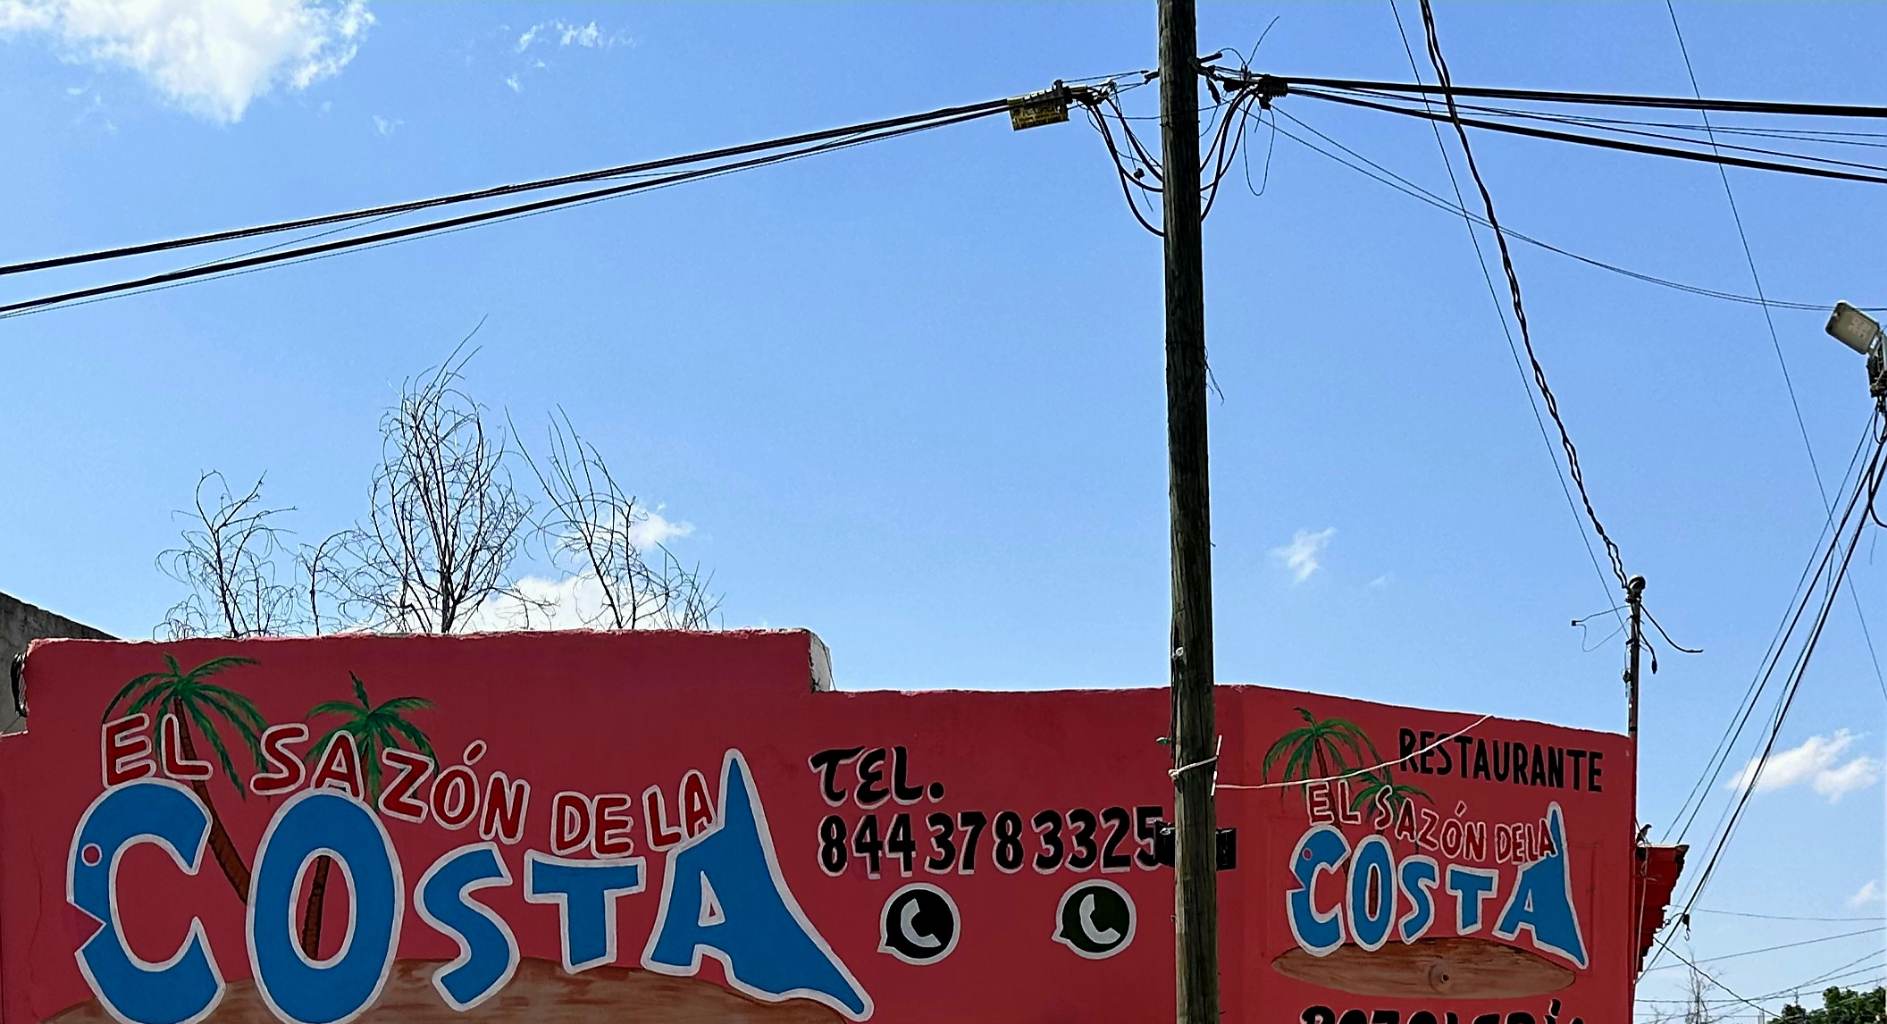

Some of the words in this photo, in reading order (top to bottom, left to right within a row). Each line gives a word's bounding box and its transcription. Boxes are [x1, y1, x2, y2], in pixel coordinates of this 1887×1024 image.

[102, 713, 213, 788] EL
[250, 723, 531, 845] SAZÓN
[551, 791, 634, 858] DE
[642, 769, 718, 852] LA
[808, 746, 945, 809] TEL.
[1399, 728, 1604, 793] RESTAURANTE
[1305, 779, 1361, 826] EL
[1375, 784, 1486, 862] SAZÓN
[1286, 801, 1589, 969] COSTA
